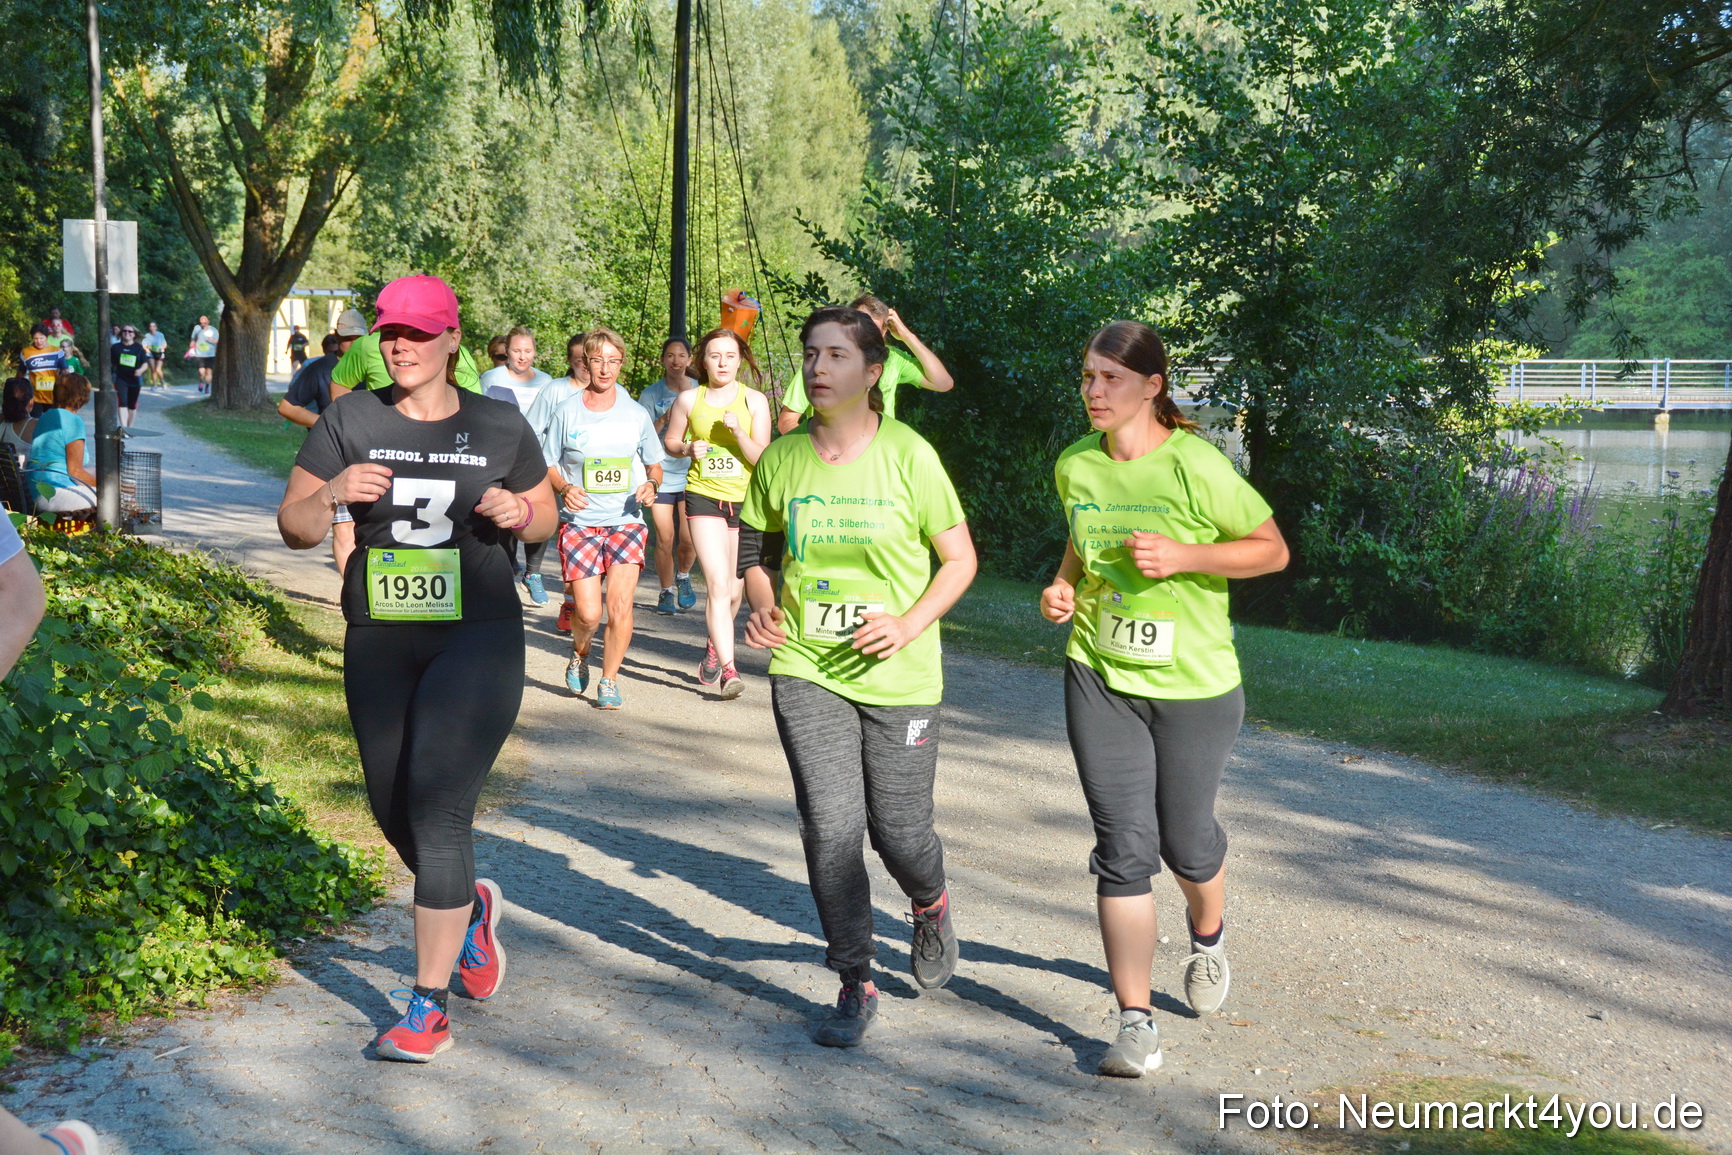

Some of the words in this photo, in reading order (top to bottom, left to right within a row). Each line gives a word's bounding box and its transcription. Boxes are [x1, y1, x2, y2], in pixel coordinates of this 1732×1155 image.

[369, 449, 424, 463] SCHOOL
[428, 453, 487, 467] RUNERS
[708, 457, 734, 470] 335
[595, 470, 621, 483] 649
[830, 495, 895, 508] Zahnarztpraxis
[391, 477, 456, 547] 3
[1105, 503, 1171, 514] Zahnarztpraxis
[811, 519, 824, 529] Dr.
[826, 519, 836, 529] R.
[839, 519, 885, 530] Silberhorn
[1087, 525, 1100, 535] Dr.
[1101, 525, 1111, 535] R.
[811, 535, 825, 544] ZA
[826, 535, 837, 545] M.
[839, 535, 873, 545] Michalk
[378, 575, 447, 600] 1930
[425, 601, 454, 609] Melissa
[818, 603, 868, 629] 715
[1111, 614, 1157, 646] 719
[1111, 640, 1127, 650] Kilian
[1128, 645, 1155, 654] Kerstin
[909, 719, 929, 729] JUST
[907, 727, 920, 737] DO
